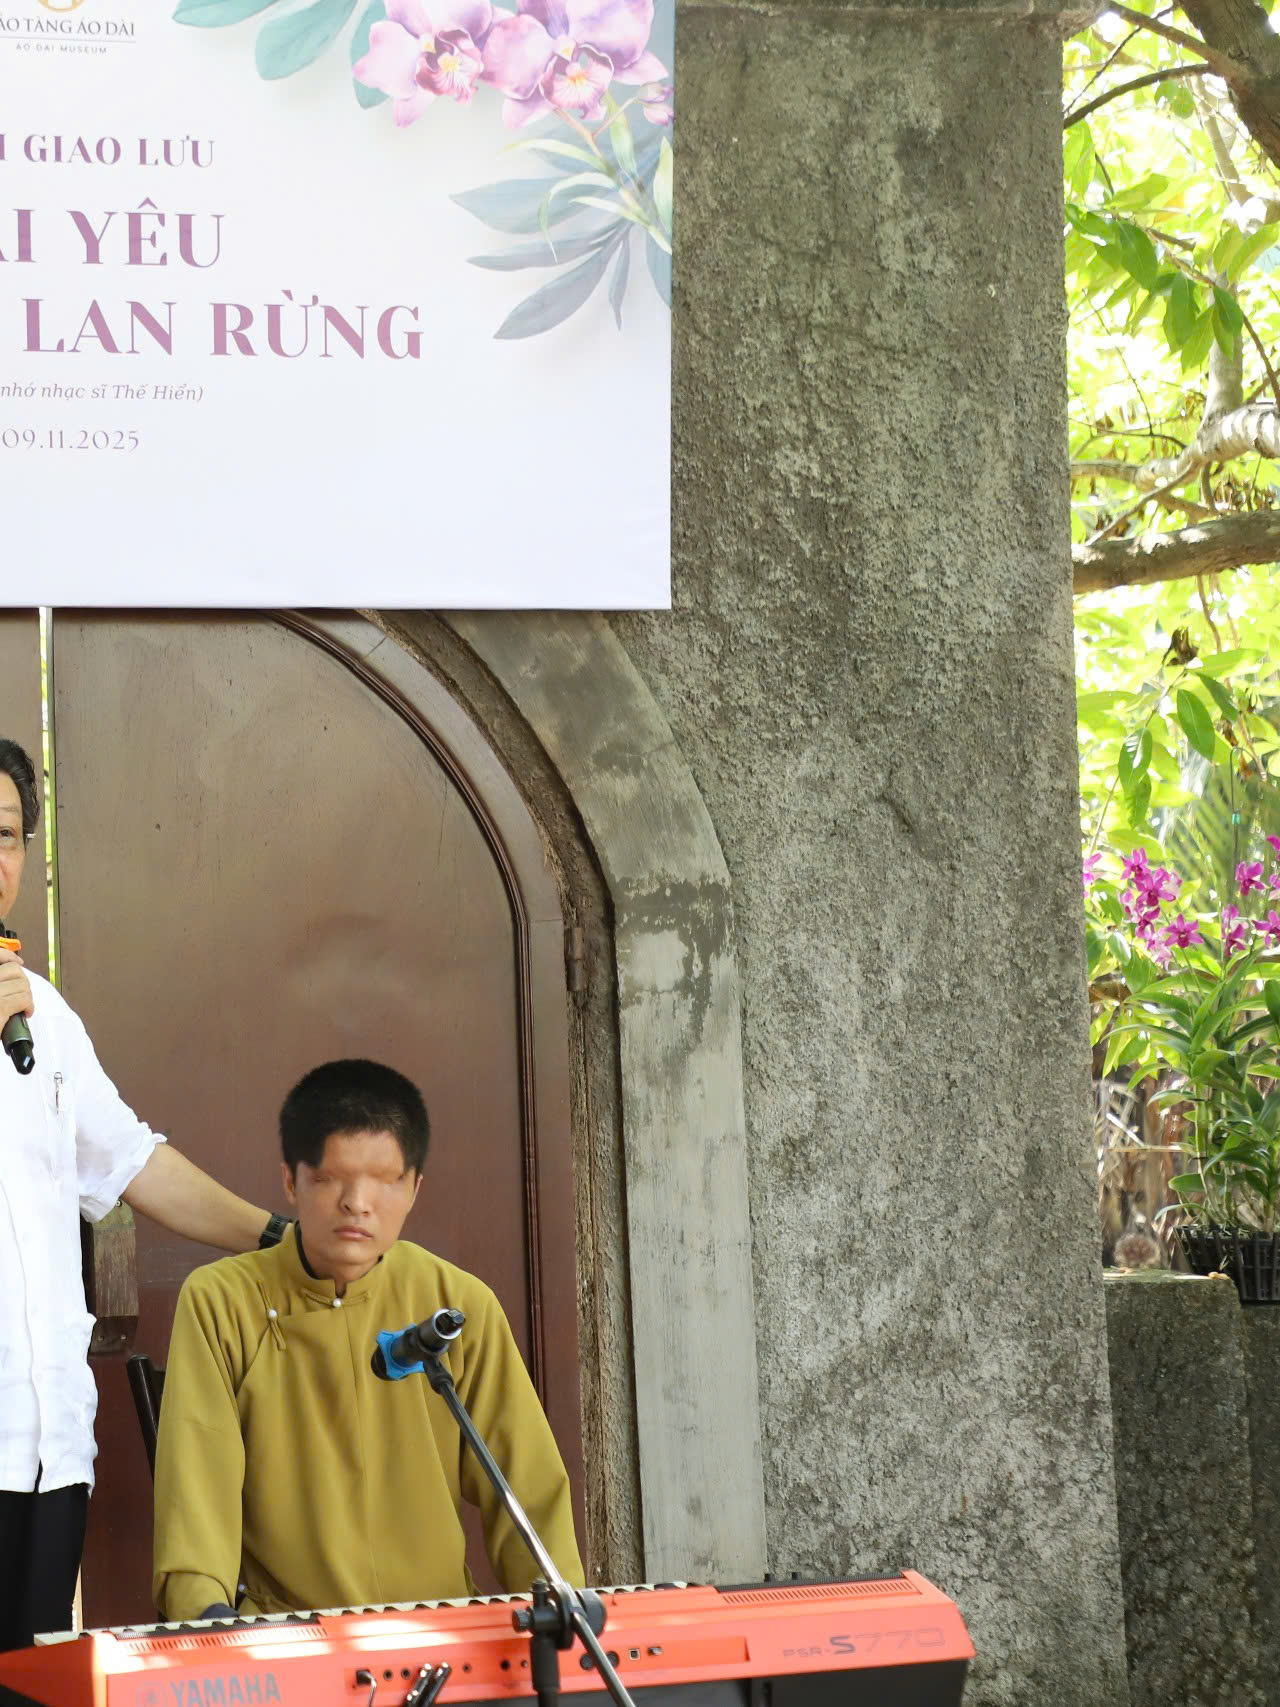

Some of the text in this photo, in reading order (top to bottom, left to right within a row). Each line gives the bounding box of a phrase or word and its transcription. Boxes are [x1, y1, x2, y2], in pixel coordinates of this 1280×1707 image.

[24, 16, 72, 33] TÀNG
[77, 17, 101, 35] ÁO
[106, 19, 135, 36] DÀI
[60, 45, 107, 54] MUSEUM
[23, 134, 121, 165] GIAO
[137, 135, 216, 168] LƯU
[66, 197, 224, 268] YÊU
[21, 299, 178, 356] LAN
[208, 289, 425, 360] RỪNG
[0, 382, 36, 398] nhớ
[41, 383, 85, 401] nhạc
[91, 384, 106, 399] sĩ
[112, 384, 148, 400] Thế
[153, 383, 204, 402] Hiển)
[1, 428, 140, 451] 09.11.2025
[171, 1672, 282, 1707] YAMAHA
